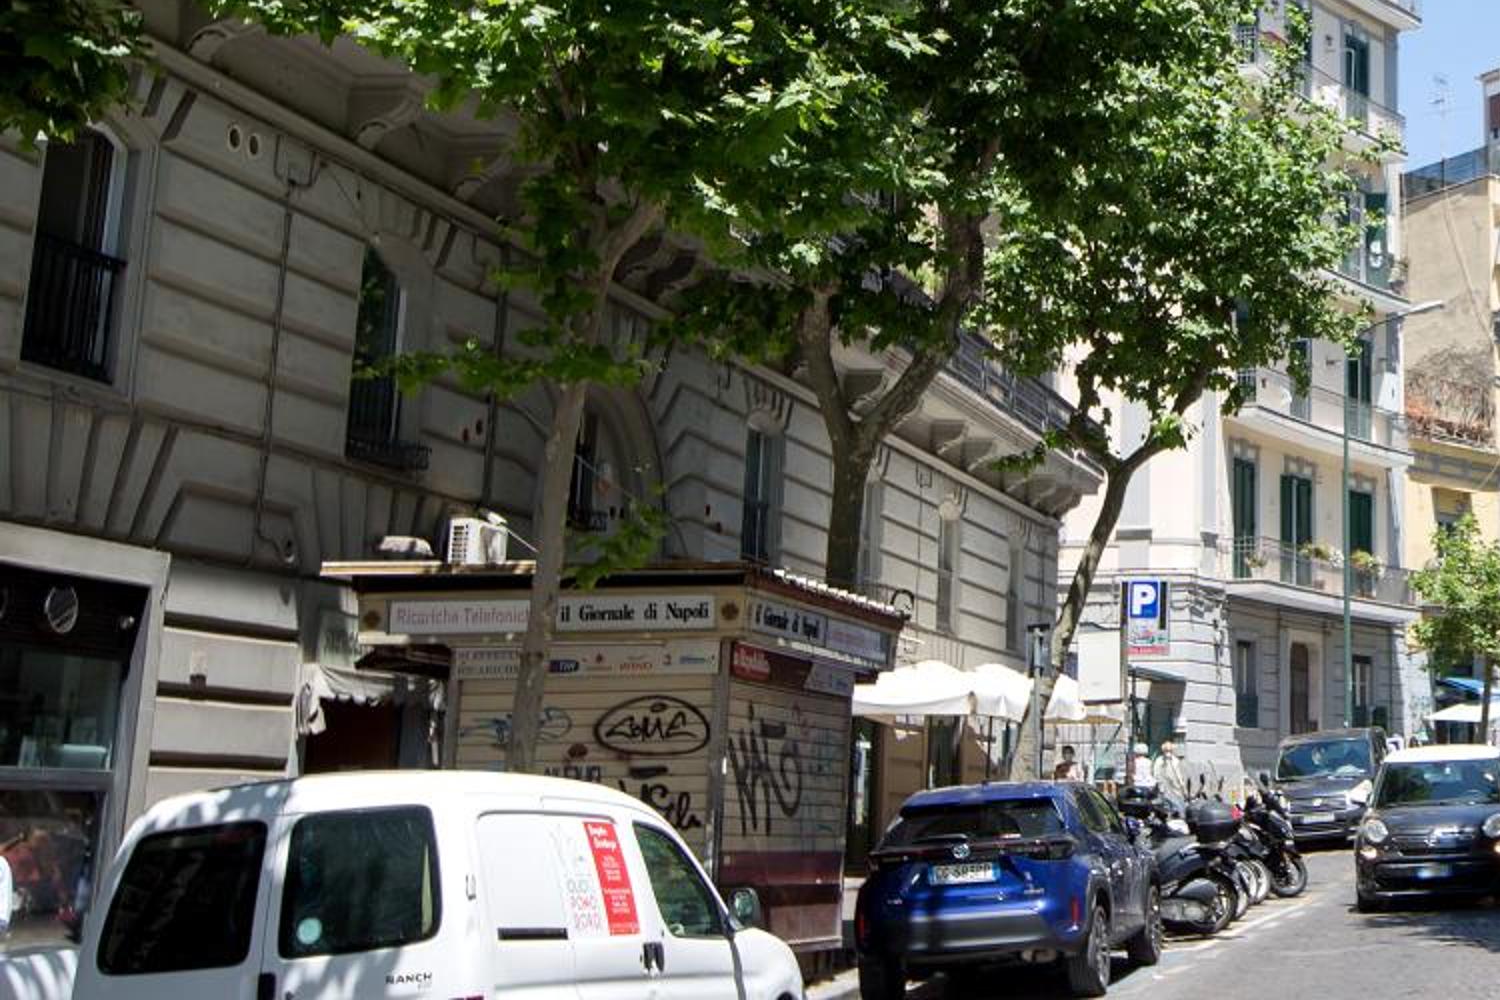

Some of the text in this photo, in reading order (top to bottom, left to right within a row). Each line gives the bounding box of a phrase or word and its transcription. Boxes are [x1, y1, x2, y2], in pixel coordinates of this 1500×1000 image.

[1131, 584, 1156, 616] P
[560, 601, 709, 623] il Giornale di Napoli
[385, 972, 432, 985] RANCH
